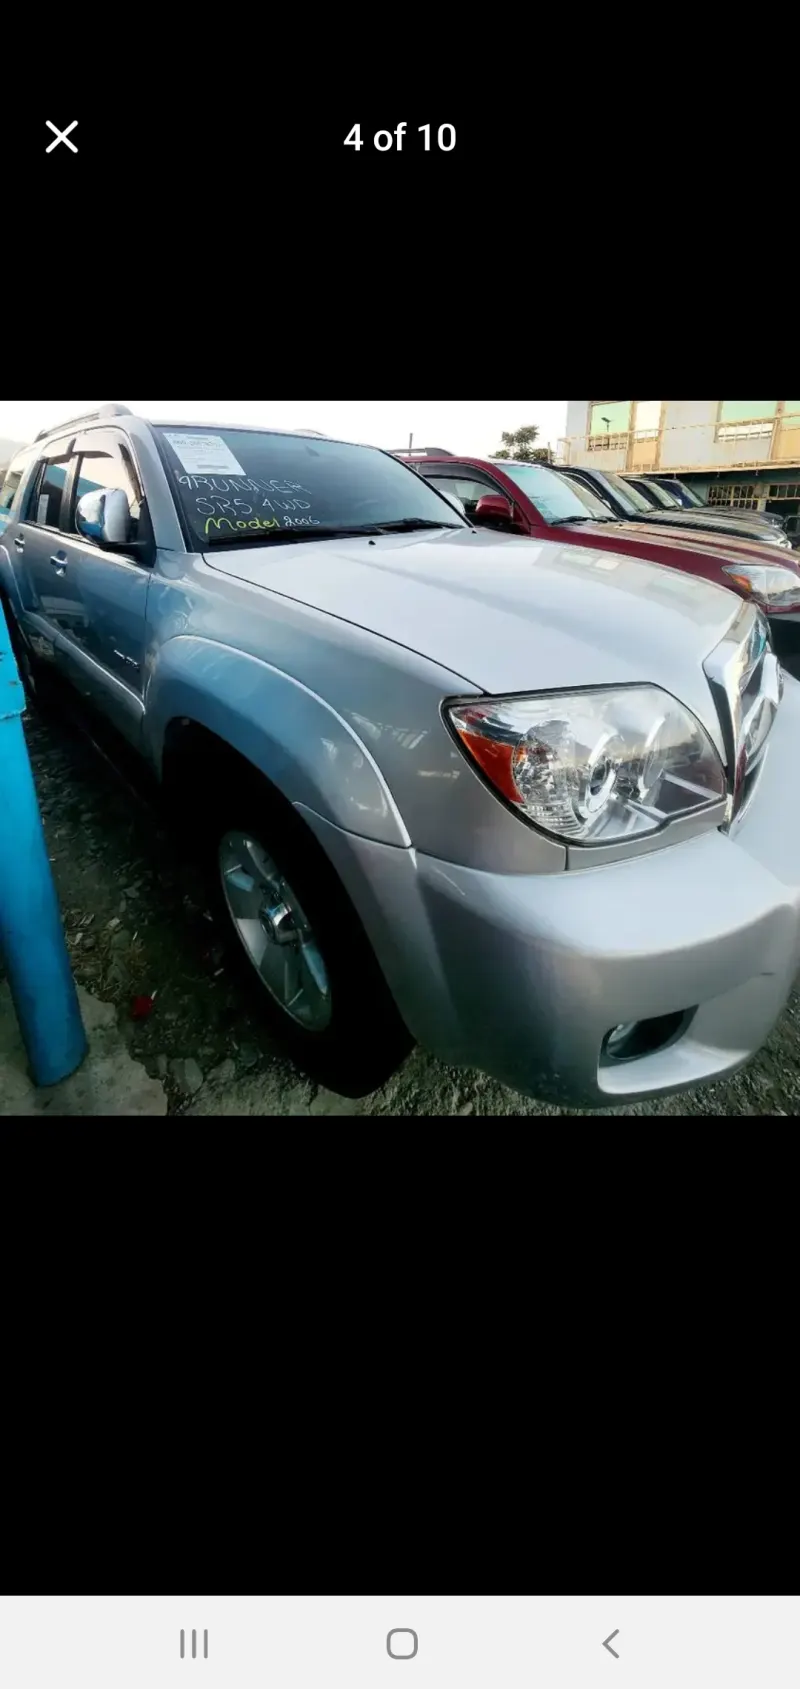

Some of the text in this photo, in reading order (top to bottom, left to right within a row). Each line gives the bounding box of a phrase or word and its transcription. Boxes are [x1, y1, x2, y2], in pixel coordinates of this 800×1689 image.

[195, 495, 253, 516] SR5
[205, 515, 320, 534] Model 2006
